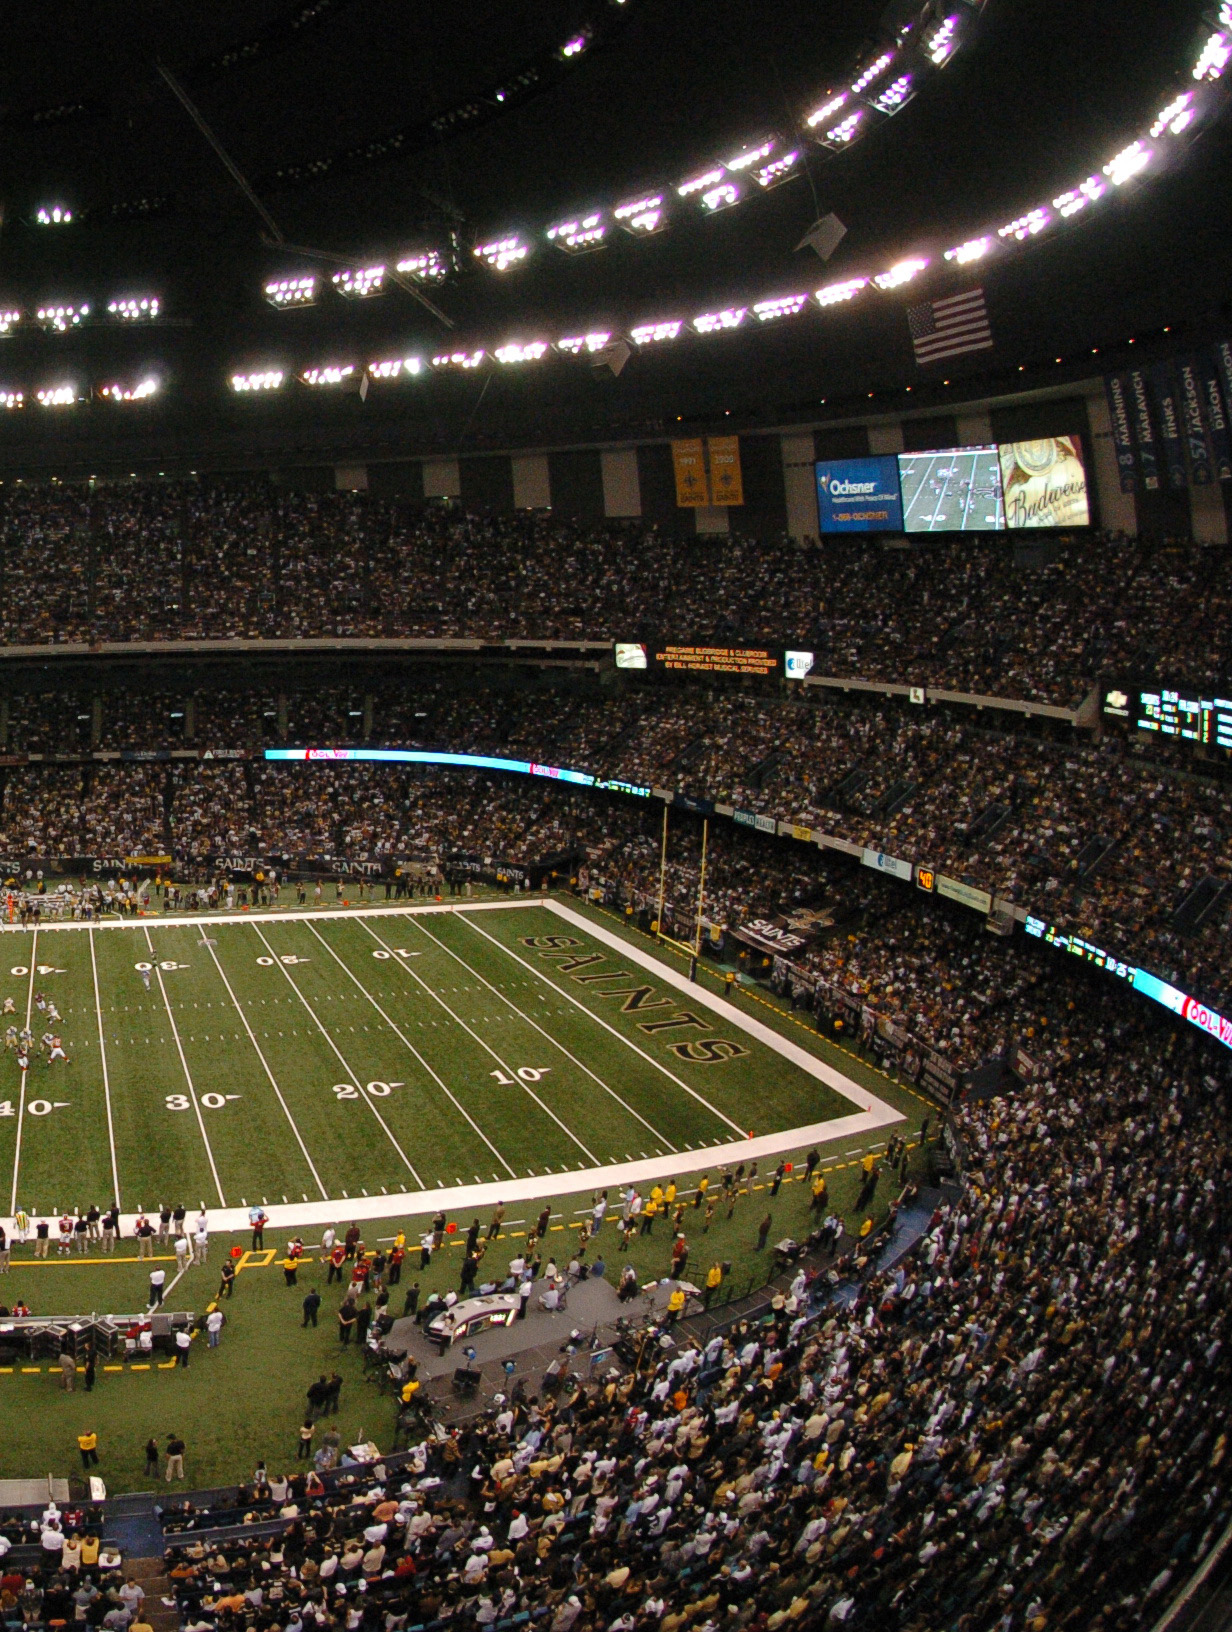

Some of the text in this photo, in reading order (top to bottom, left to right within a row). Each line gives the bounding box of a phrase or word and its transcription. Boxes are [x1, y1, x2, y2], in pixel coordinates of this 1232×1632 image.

[1131, 371, 1153, 442] MARAVICH
[1182, 366, 1203, 433] JACKSON
[1208, 380, 1225, 430] DIXON
[1110, 378, 1131, 446] MANNING
[1162, 397, 1178, 438] FINKS
[1189, 437, 1207, 459] 57
[1118, 453, 1134, 466] 8
[829, 479, 877, 496] Ochsner
[734, 811, 755, 826] PEOPLES
[919, 869, 933, 889] 40
[747, 918, 806, 947] SAINTS
[256, 954, 298, 966] 20
[372, 948, 406, 960] 10
[10, 965, 55, 976] 40
[134, 960, 179, 972] 30
[518, 935, 751, 1064] SAINTS
[490, 1065, 543, 1085] 10
[332, 1080, 392, 1100] 20
[165, 1092, 226, 1111] 30
